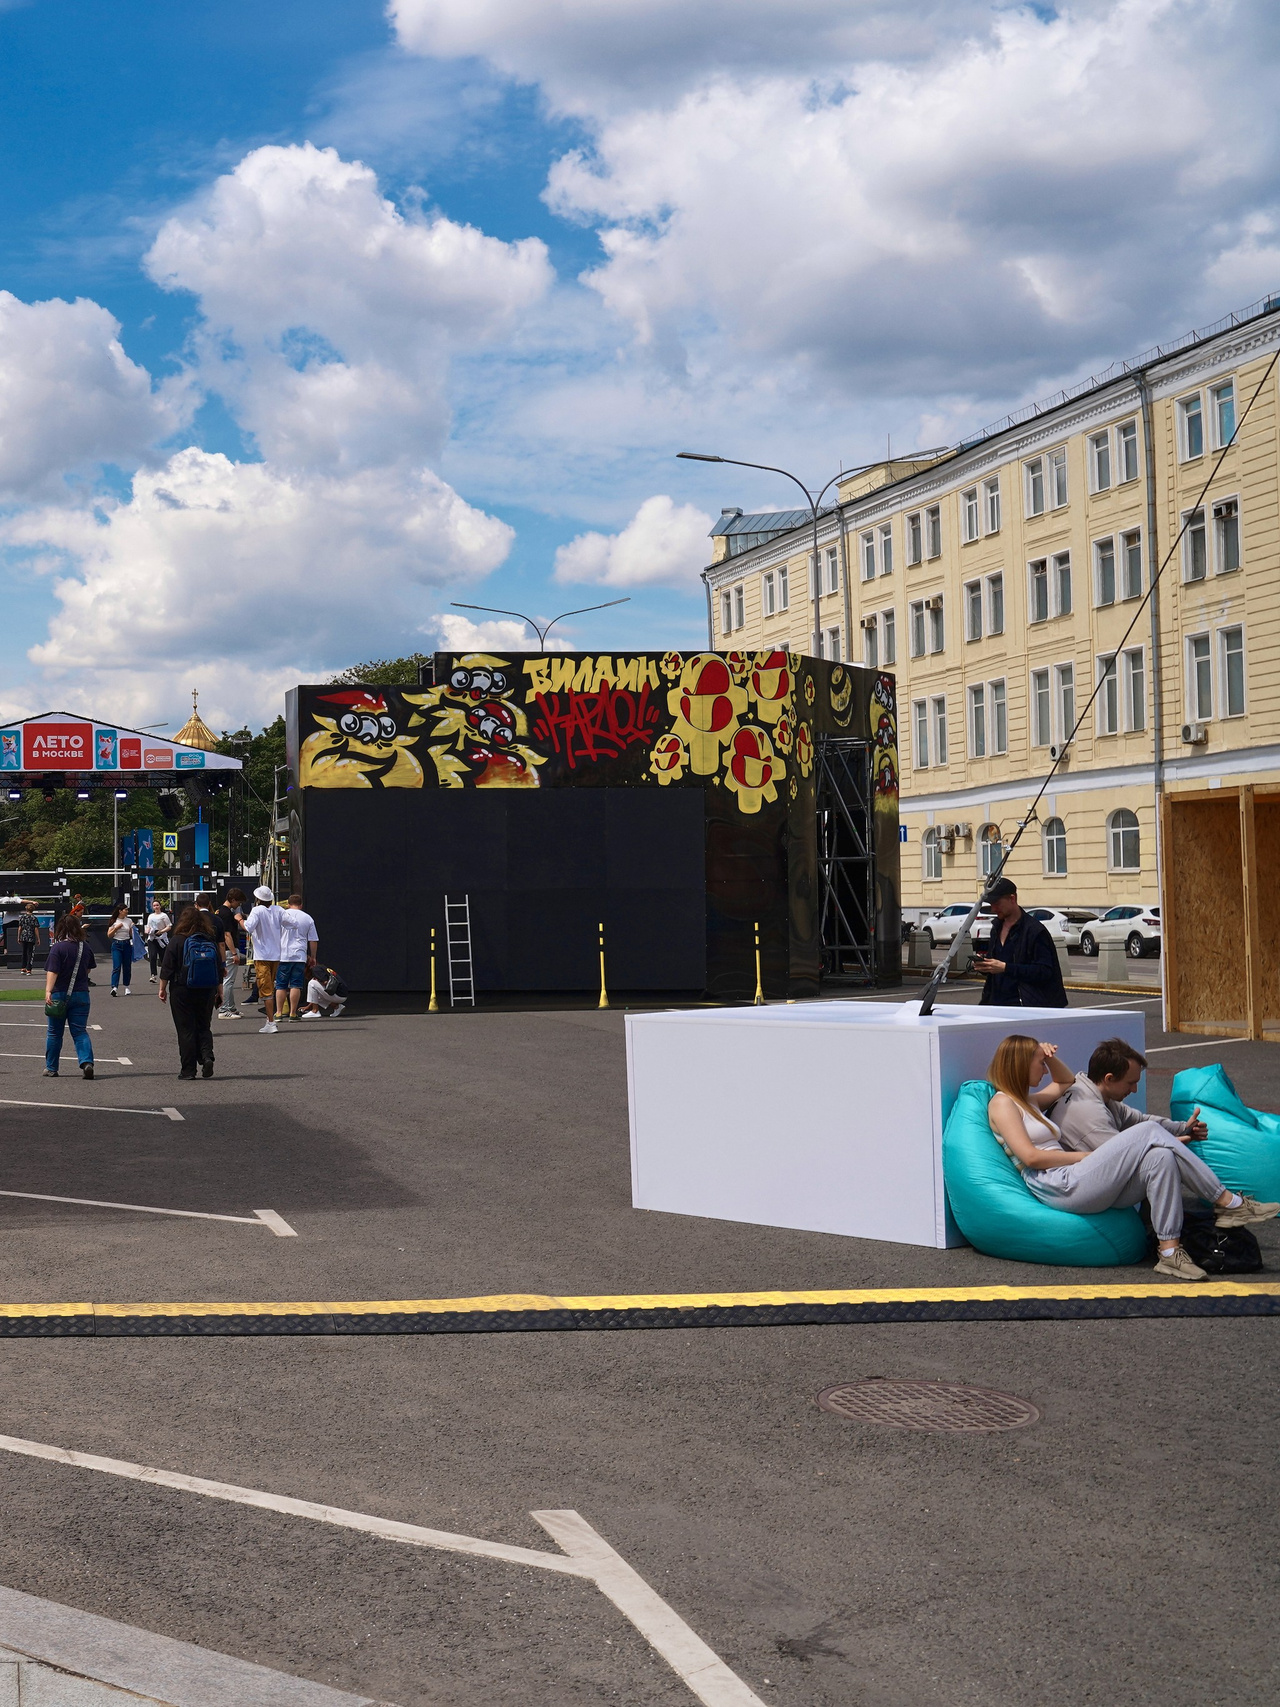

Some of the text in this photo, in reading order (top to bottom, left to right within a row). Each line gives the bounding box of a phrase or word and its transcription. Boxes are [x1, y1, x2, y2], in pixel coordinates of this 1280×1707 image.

[33, 735, 84, 749] ЛЕТО
[32, 750, 84, 758] В МОСКВЕ
